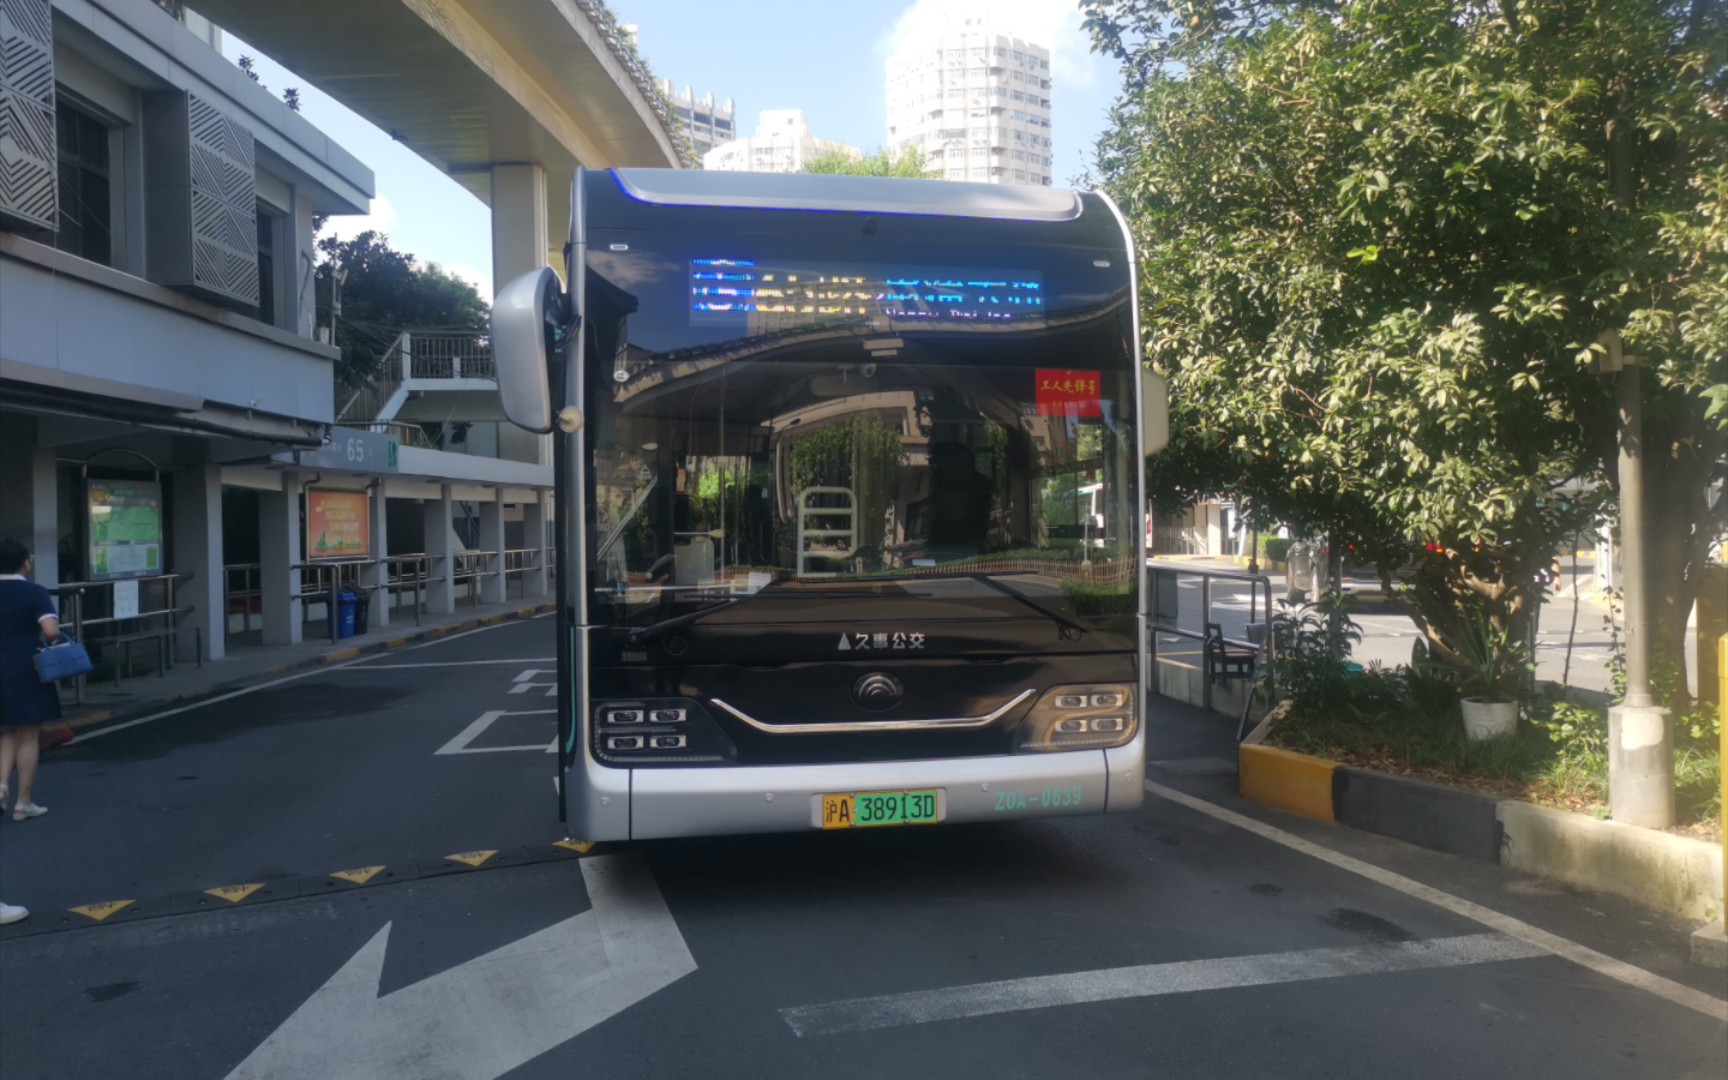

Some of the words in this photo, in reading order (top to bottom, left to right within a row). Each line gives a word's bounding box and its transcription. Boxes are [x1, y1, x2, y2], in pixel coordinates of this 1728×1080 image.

[1040, 379, 1097, 396] 工人先锋号
[347, 438, 364, 462] 65
[855, 632, 925, 650] 久事公交
[826, 798, 850, 823] 沪A
[860, 794, 935, 822] 38913D
